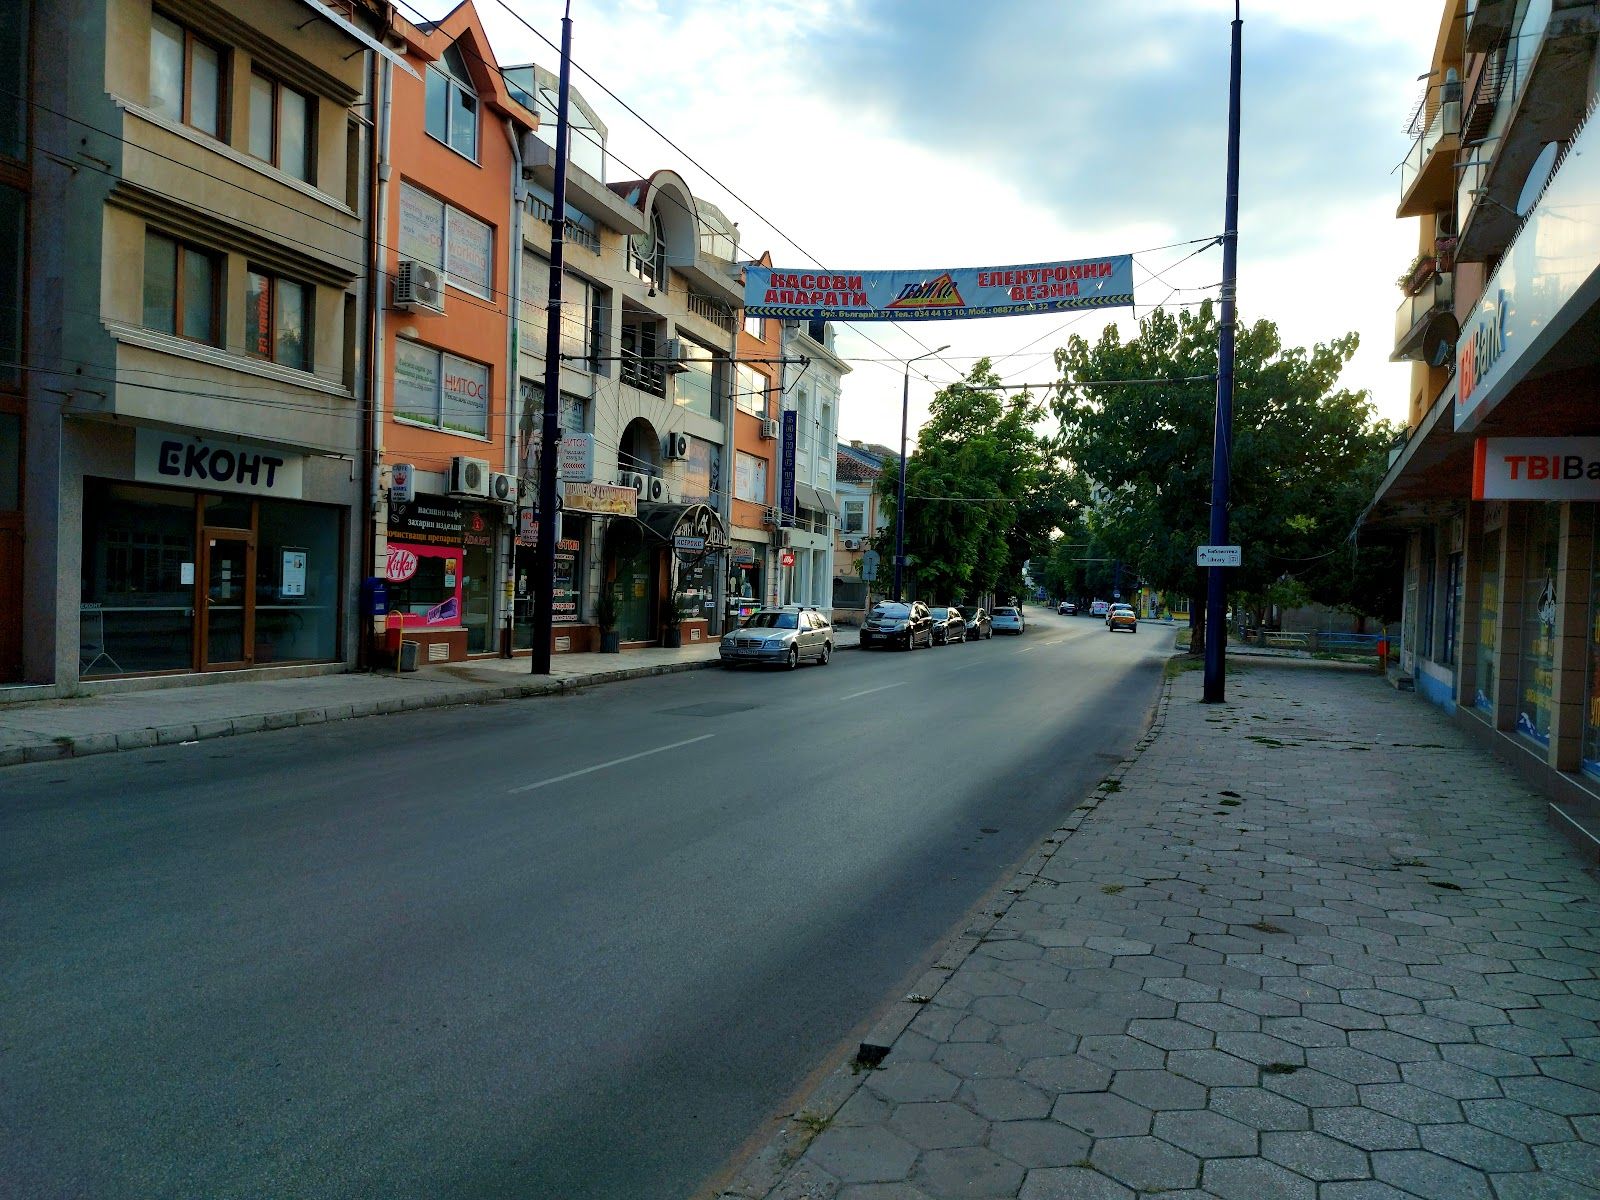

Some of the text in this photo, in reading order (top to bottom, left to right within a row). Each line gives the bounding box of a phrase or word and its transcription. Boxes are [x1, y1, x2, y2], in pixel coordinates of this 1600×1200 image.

[769, 272, 863, 291] КАСОВИ
[977, 262, 1113, 287] ЕЛЕКТРОННИ
[763, 289, 868, 307] АПАРАТИ
[1010, 281, 1079, 302] ВЕЗНИ
[820, 310, 837, 319] бул.
[838, 310, 879, 320] България
[914, 310, 930, 318] 034
[930, 309, 941, 317] 44
[992, 305, 1014, 314] 0887
[1038, 302, 1049, 310] 32
[445, 373, 484, 400] НИТОС
[158, 440, 283, 488] ЕКОНТ
[417, 506, 462, 520] насипно кафе
[407, 518, 462, 532] захарни изделия
[387, 551, 413, 577] KitKat
